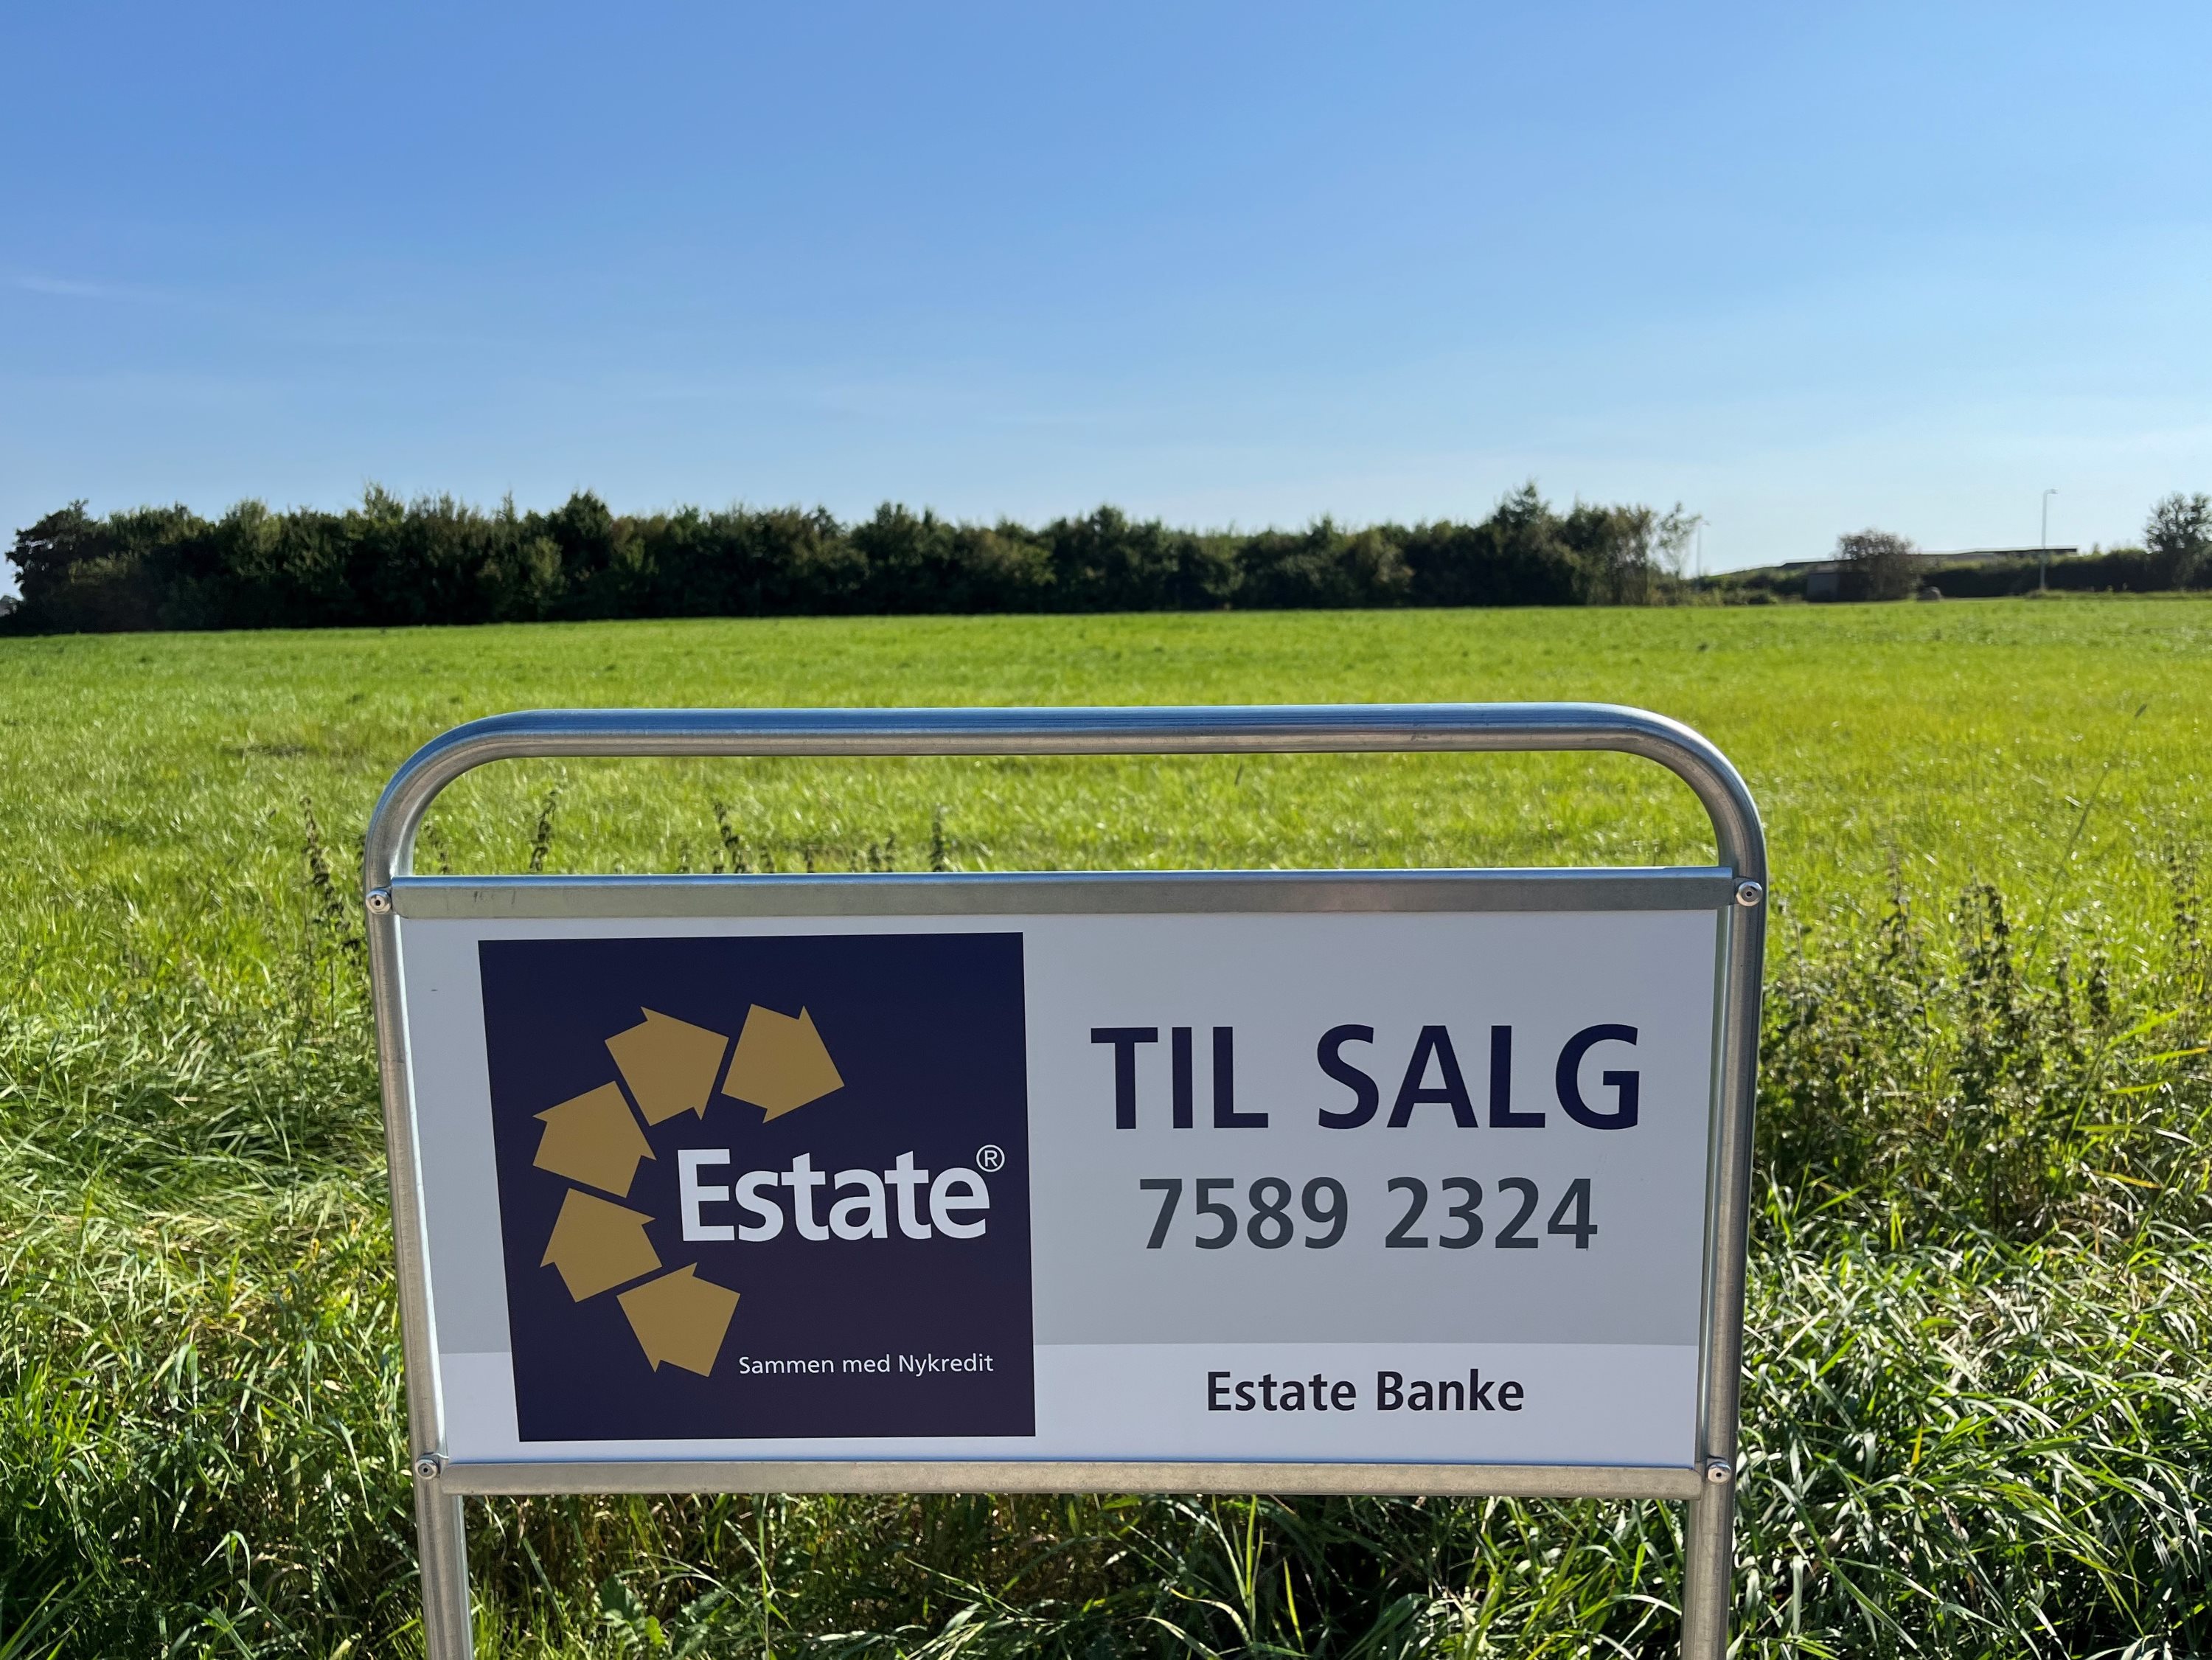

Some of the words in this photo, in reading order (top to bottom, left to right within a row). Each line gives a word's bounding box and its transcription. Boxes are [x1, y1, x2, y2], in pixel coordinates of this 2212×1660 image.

[1091, 1027, 1269, 1129] TIL
[1318, 1024, 1639, 1130] SALG
[1140, 1177, 1348, 1250] 7589
[1385, 1177, 1598, 1249] 2324
[739, 1356, 835, 1375] Sammen
[843, 1353, 891, 1373] med
[899, 1352, 994, 1377] Nykredit
[1208, 1371, 1357, 1411] Estate
[1377, 1368, 1524, 1411] Banke
